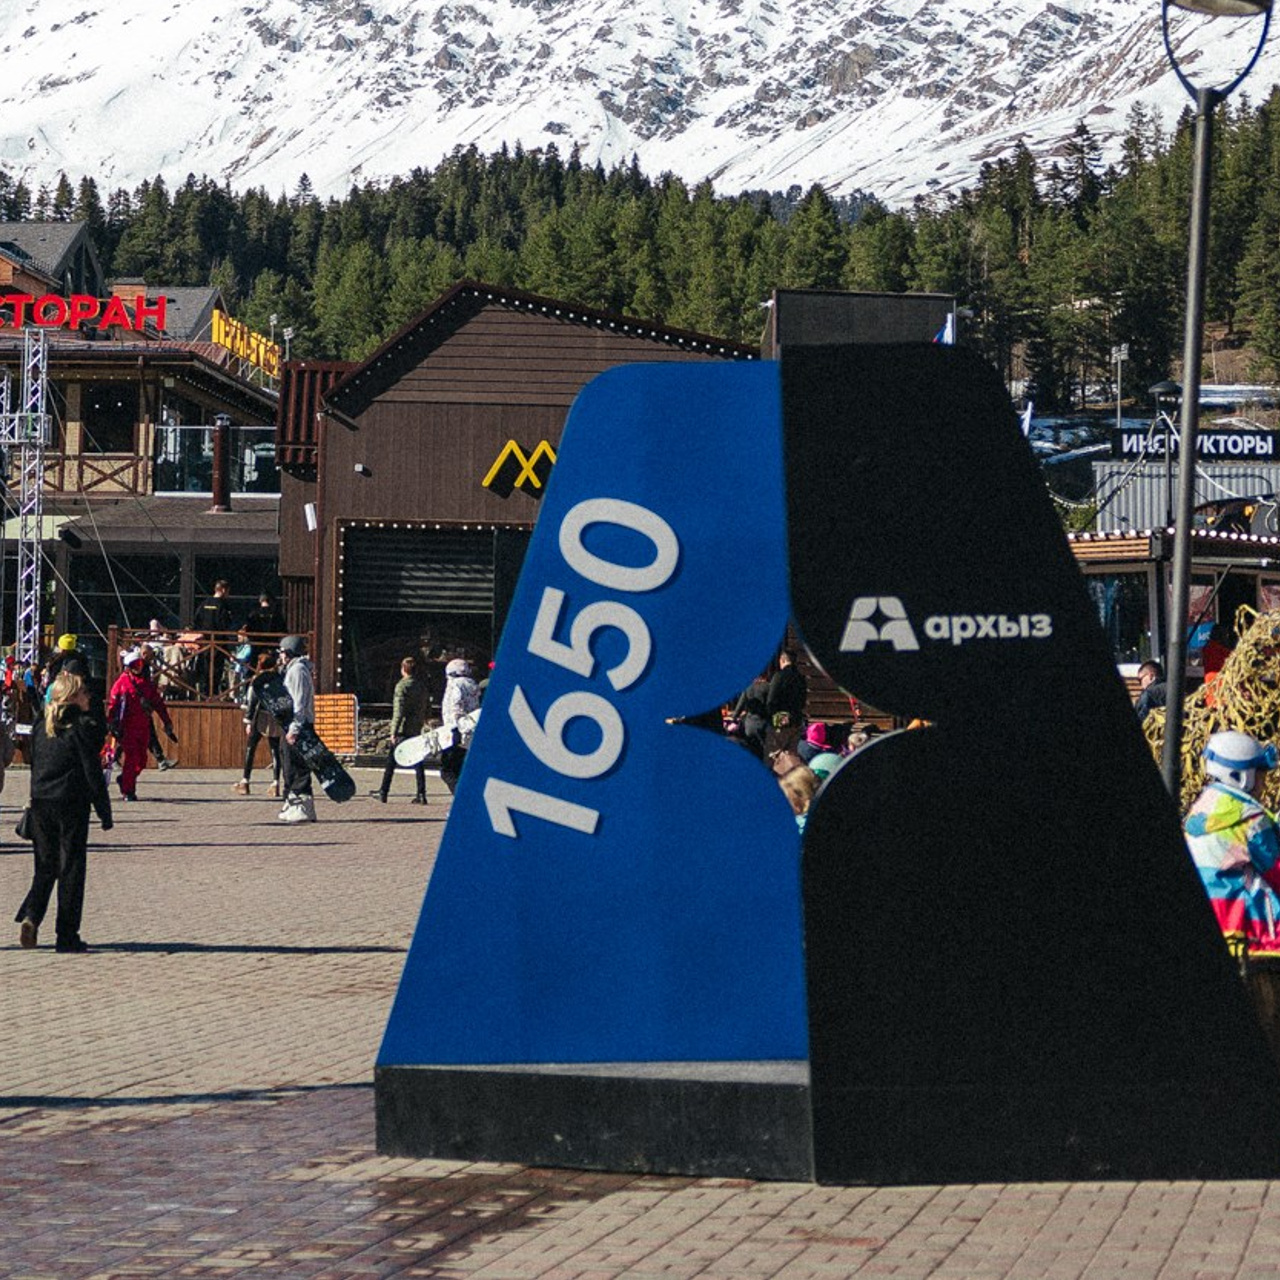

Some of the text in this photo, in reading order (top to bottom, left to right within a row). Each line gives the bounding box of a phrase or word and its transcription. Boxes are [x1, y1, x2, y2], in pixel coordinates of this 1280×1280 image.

[1122, 434, 1273, 454] ИНСТКТОРЫ
[924, 613, 1053, 645] архыз
[483, 497, 680, 839] 1650
